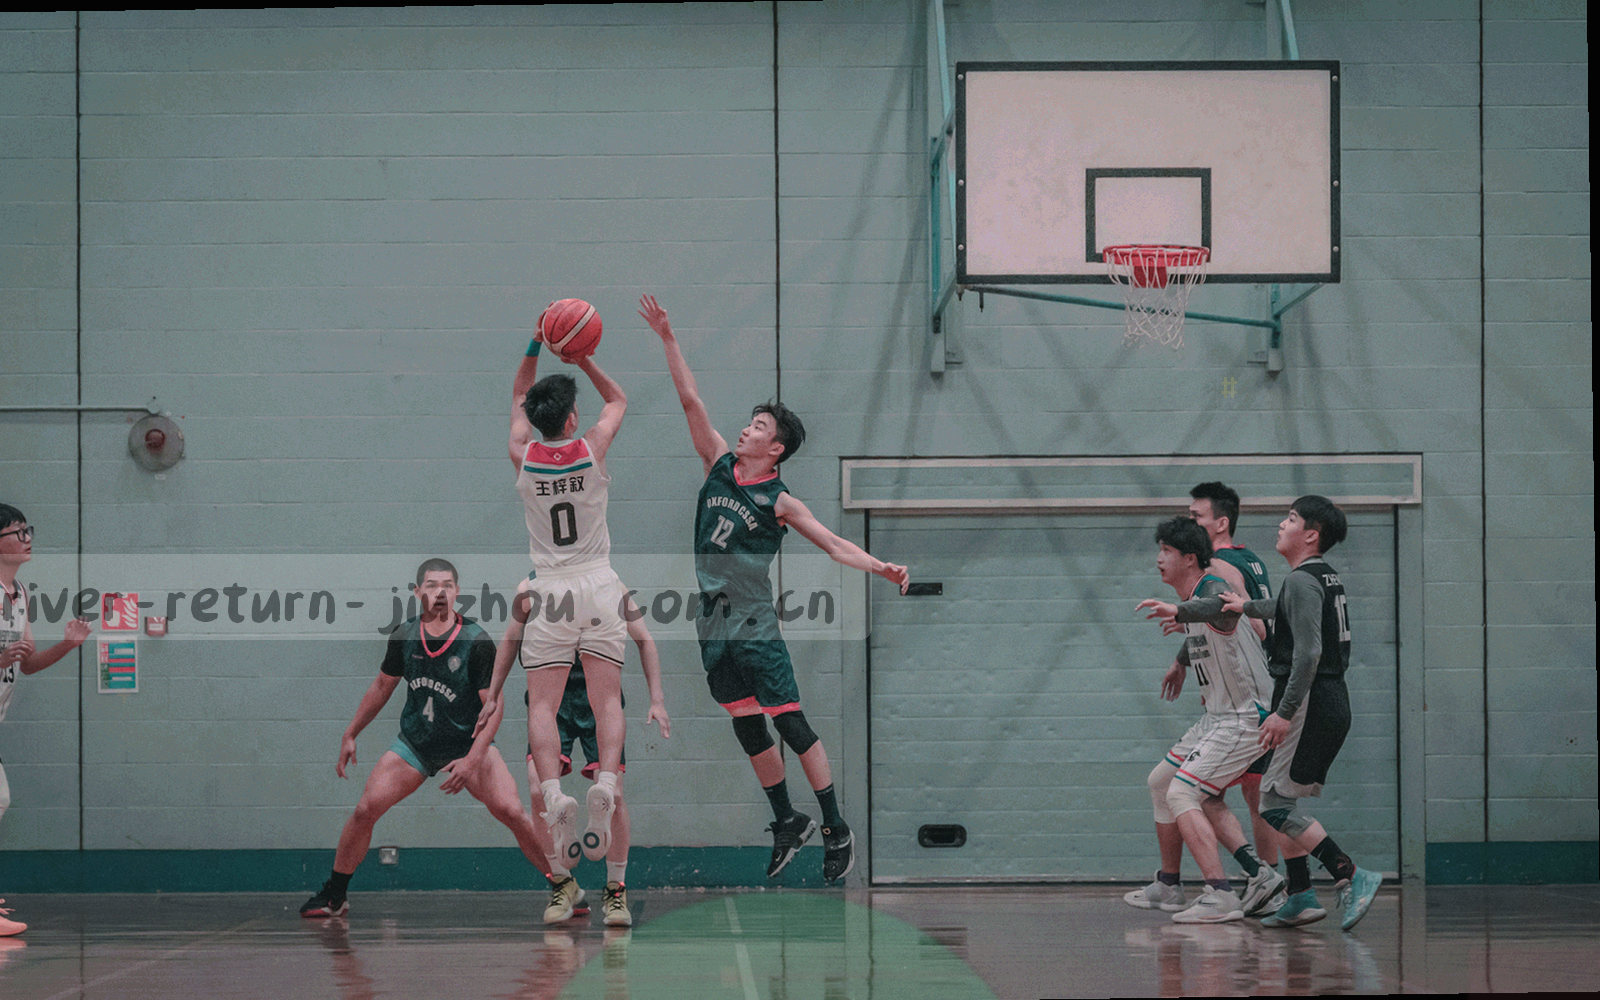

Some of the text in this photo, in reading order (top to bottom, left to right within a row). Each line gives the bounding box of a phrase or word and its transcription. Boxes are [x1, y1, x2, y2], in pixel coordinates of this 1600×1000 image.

[535, 476, 585, 496] 王梓叙
[550, 502, 578, 546] 0
[711, 515, 735, 549] 12
[422, 696, 435, 722] 4
